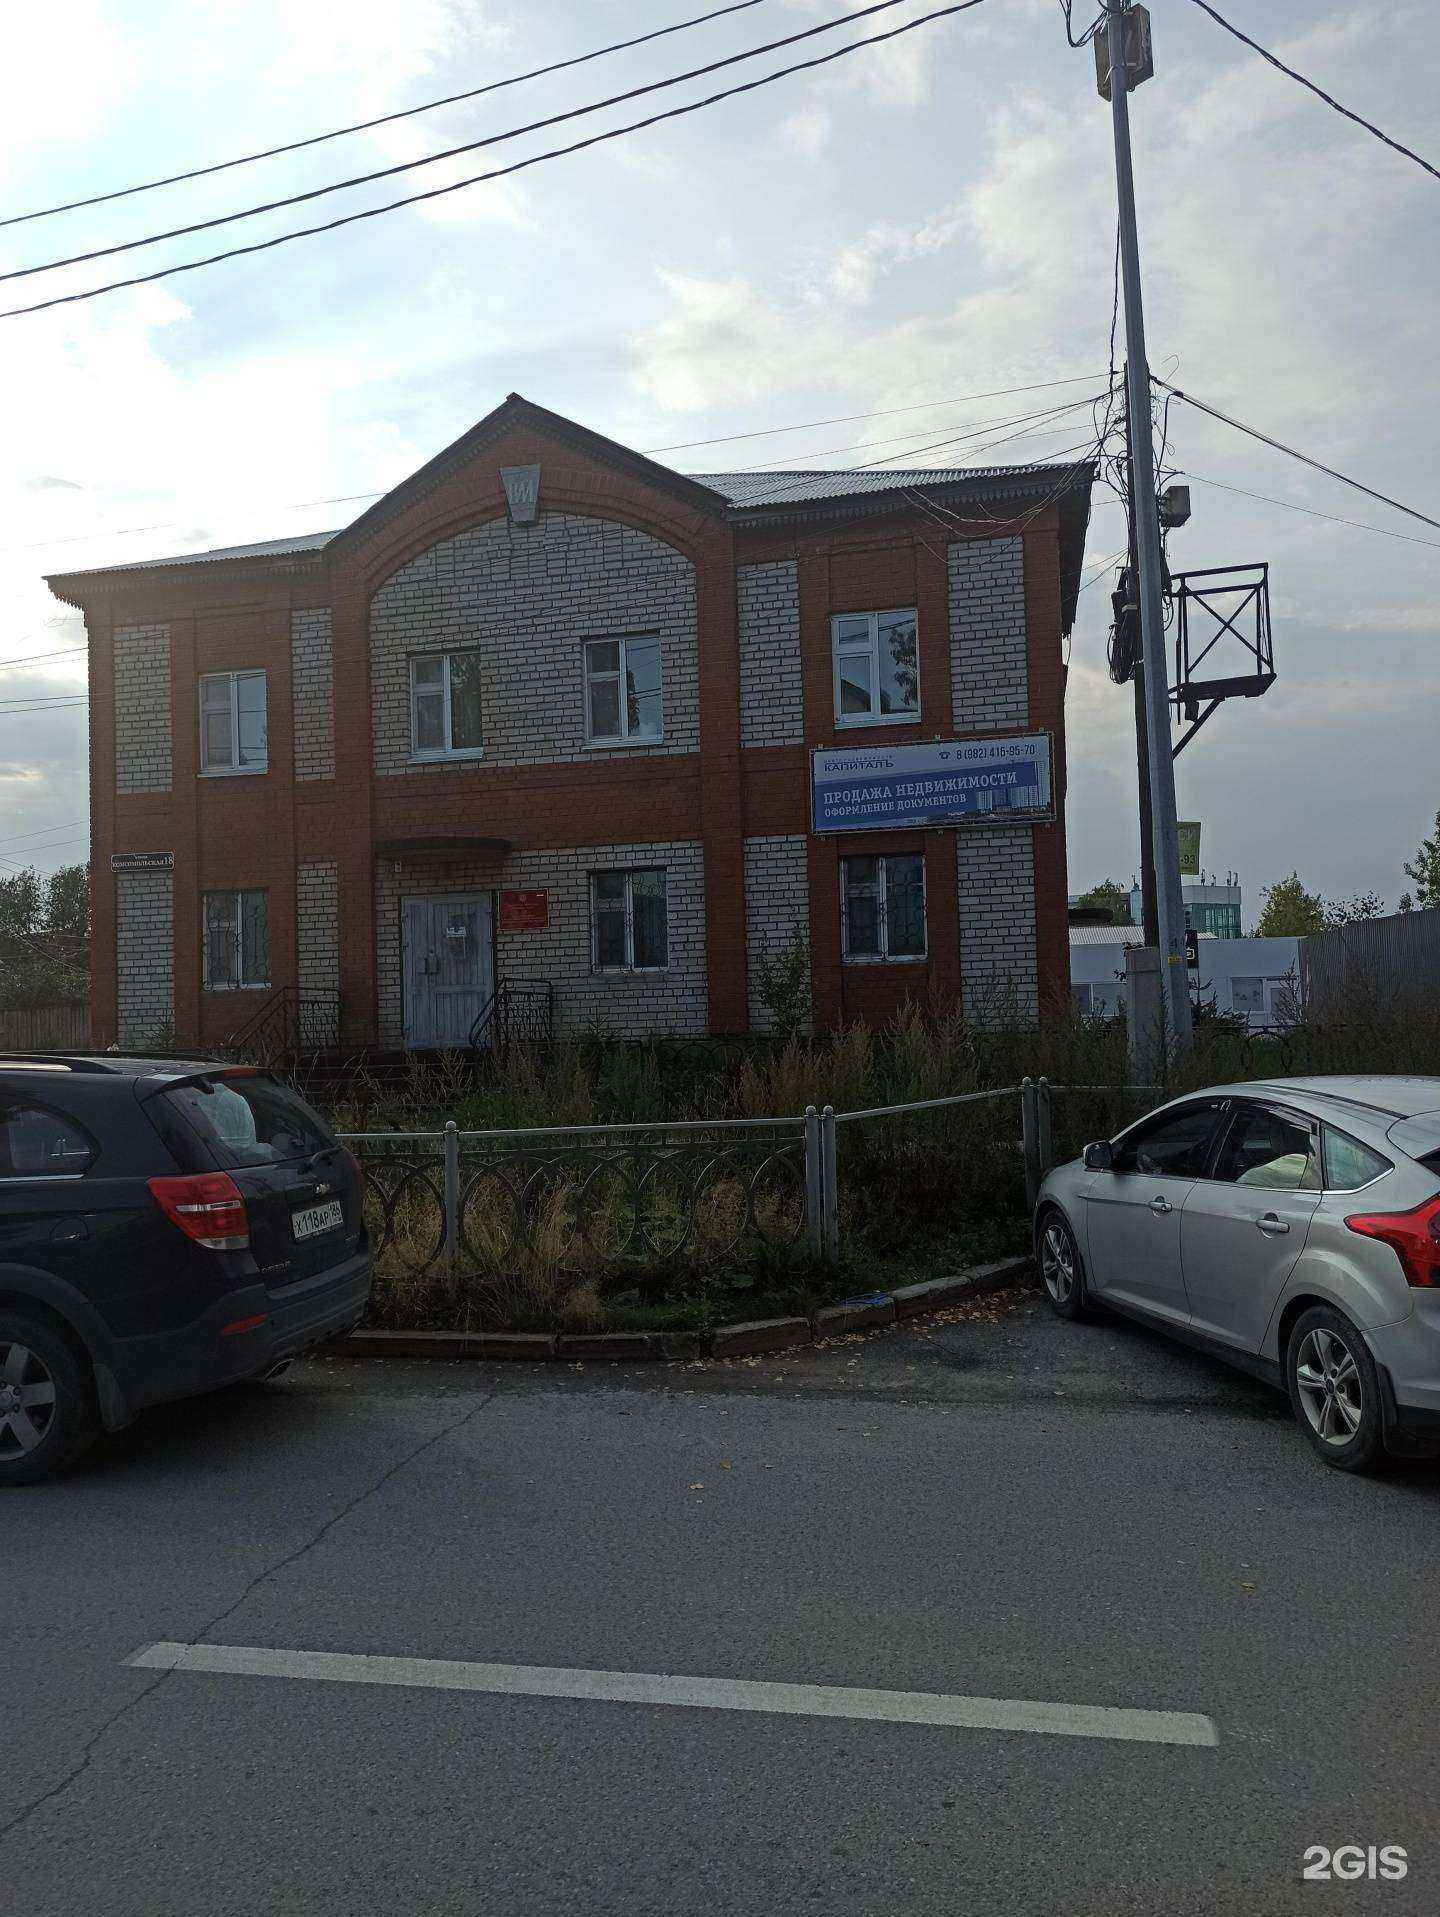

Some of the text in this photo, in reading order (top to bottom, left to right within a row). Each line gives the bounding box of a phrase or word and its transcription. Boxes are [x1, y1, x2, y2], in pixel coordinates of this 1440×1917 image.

[956, 749, 962, 760] 8
[964, 748, 987, 760] (982)
[824, 760, 895, 771] КАПИТАЛЪ
[823, 771, 1018, 805] ПРОДАЖА НЕДВИЖИМОСТИ
[824, 793, 967, 818] ОФОРМЛЕНИЕ ДОКУМЕНТОВ
